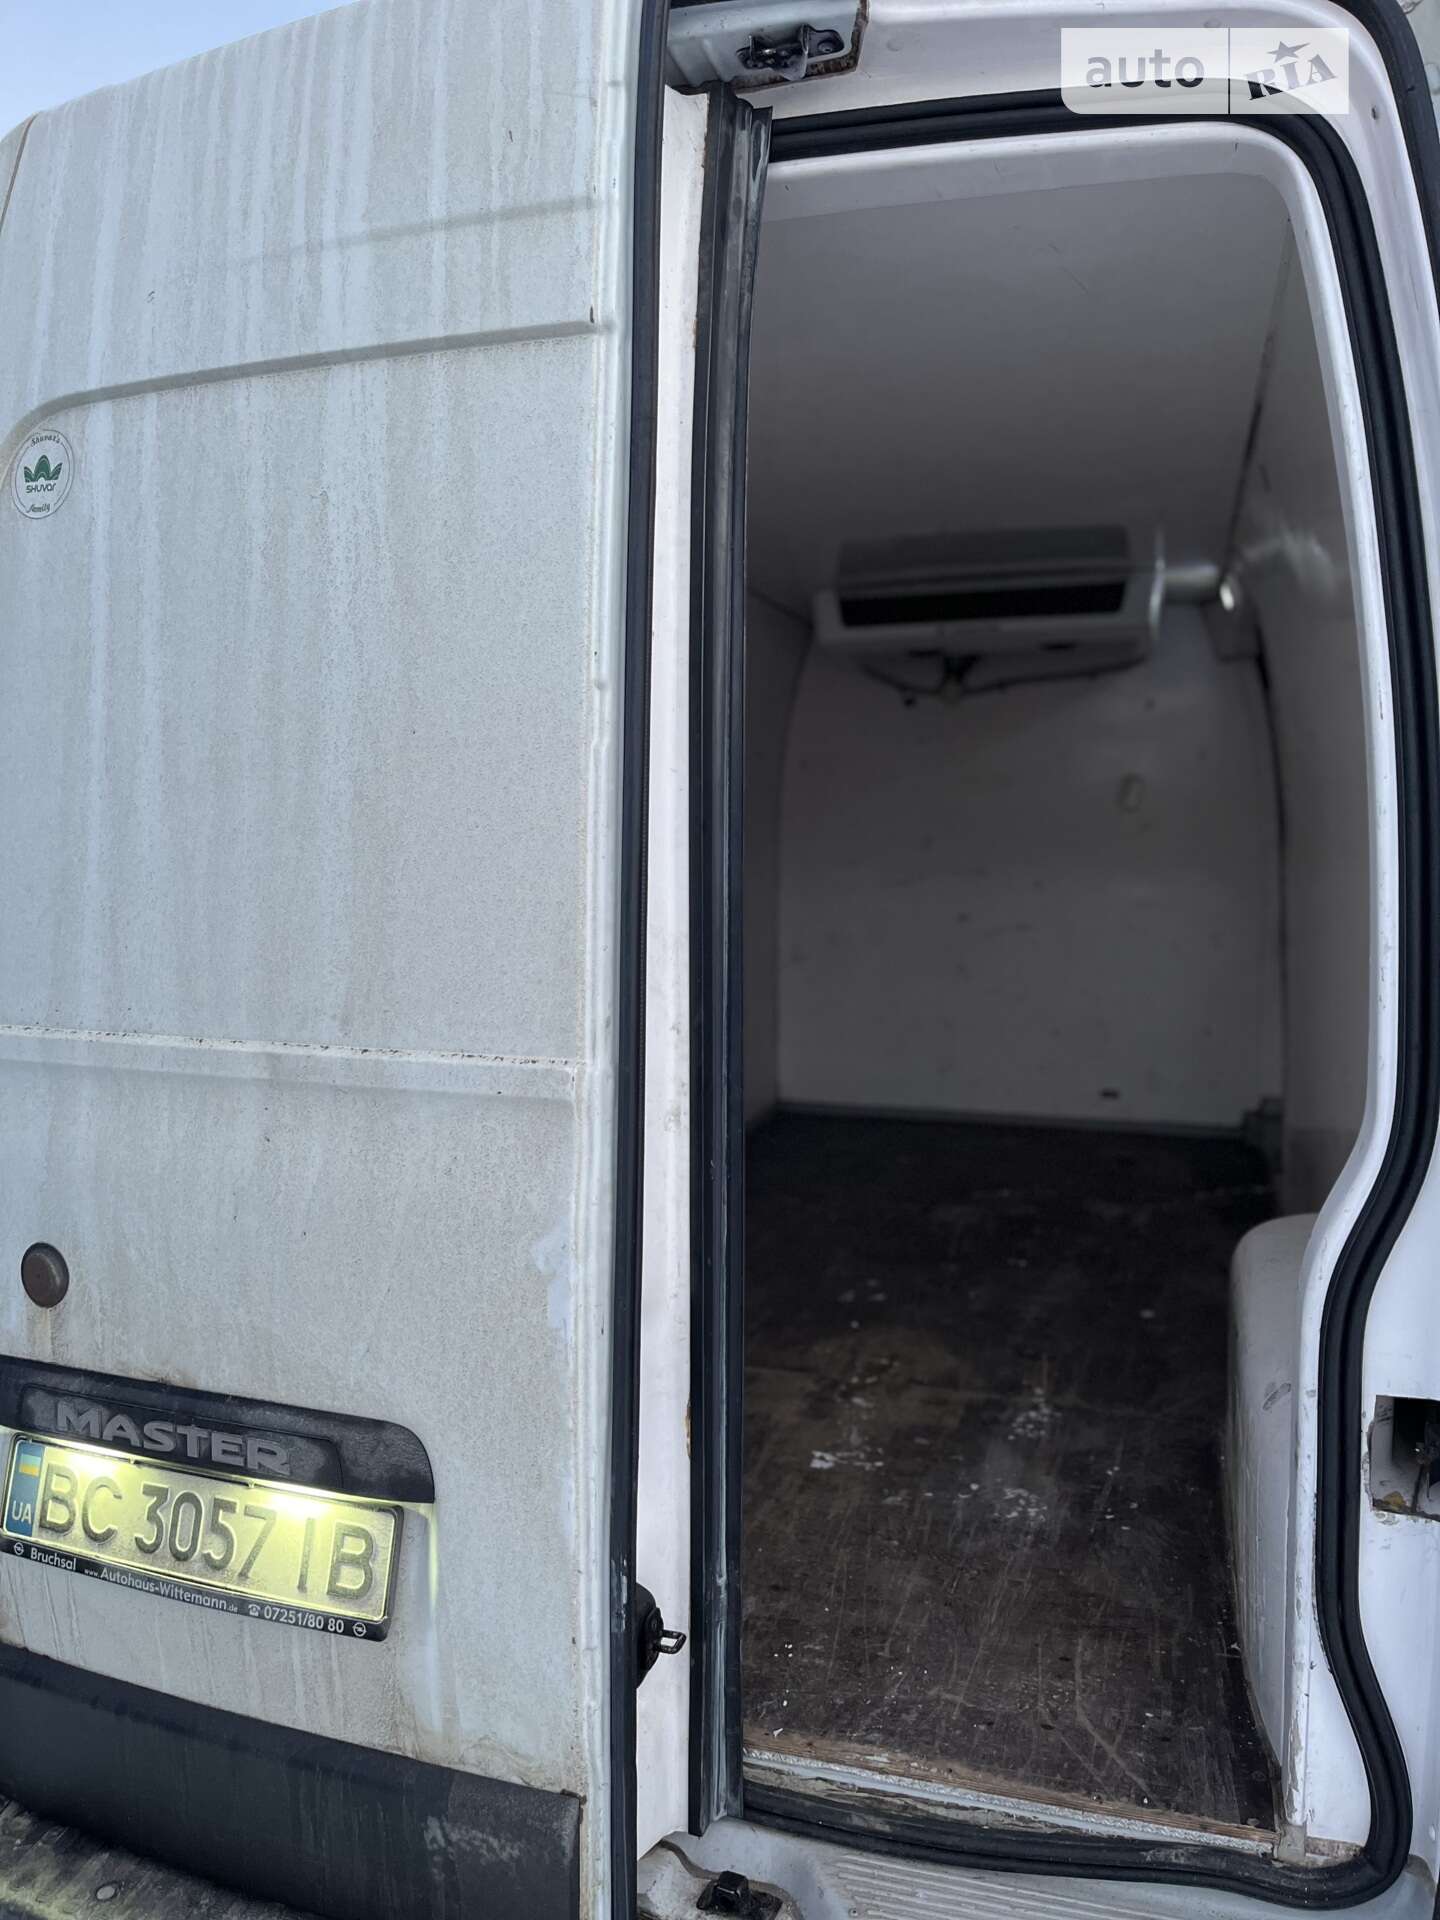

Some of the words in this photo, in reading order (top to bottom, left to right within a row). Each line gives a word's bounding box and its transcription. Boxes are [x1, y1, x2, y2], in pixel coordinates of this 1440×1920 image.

[56, 1400, 291, 1475] MASTER
[11, 1500, 33, 1522] UA
[38, 1464, 123, 1544] BC
[134, 1484, 278, 1579] 3057
[297, 1517, 376, 1599] IB
[30, 1547, 77, 1571] Bruchsal
[264, 1605, 324, 1629] 07251/80
[327, 1617, 345, 1633] 80
